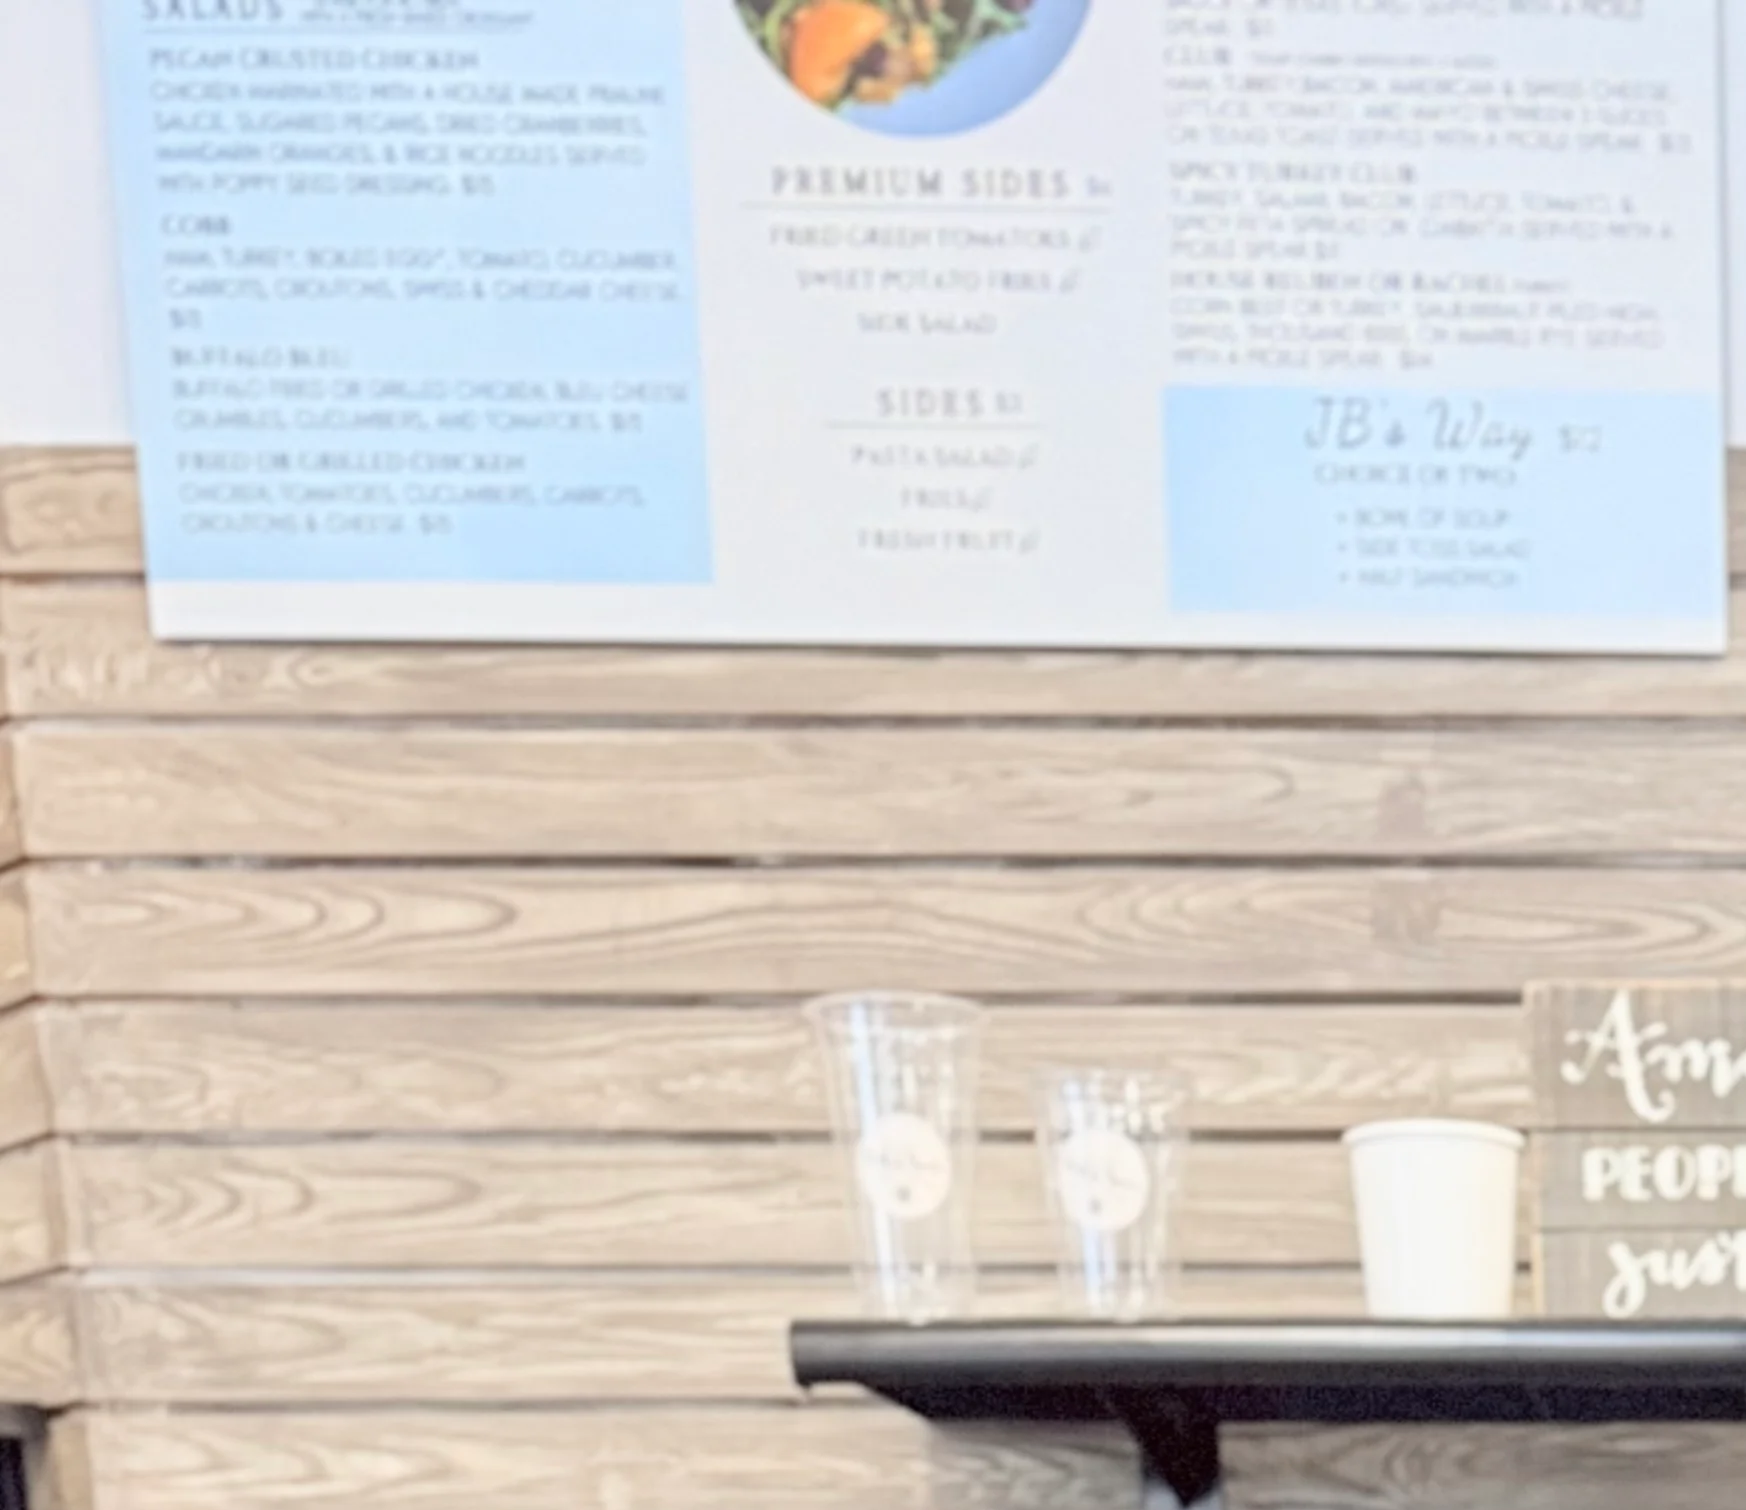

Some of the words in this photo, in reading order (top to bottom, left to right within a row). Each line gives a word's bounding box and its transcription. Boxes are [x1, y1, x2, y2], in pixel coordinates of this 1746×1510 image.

[771, 167, 943, 198] PREMIUM
[961, 168, 1068, 199] SIDES
[877, 389, 983, 417] SIDES
[1426, 396, 1532, 461] Way
